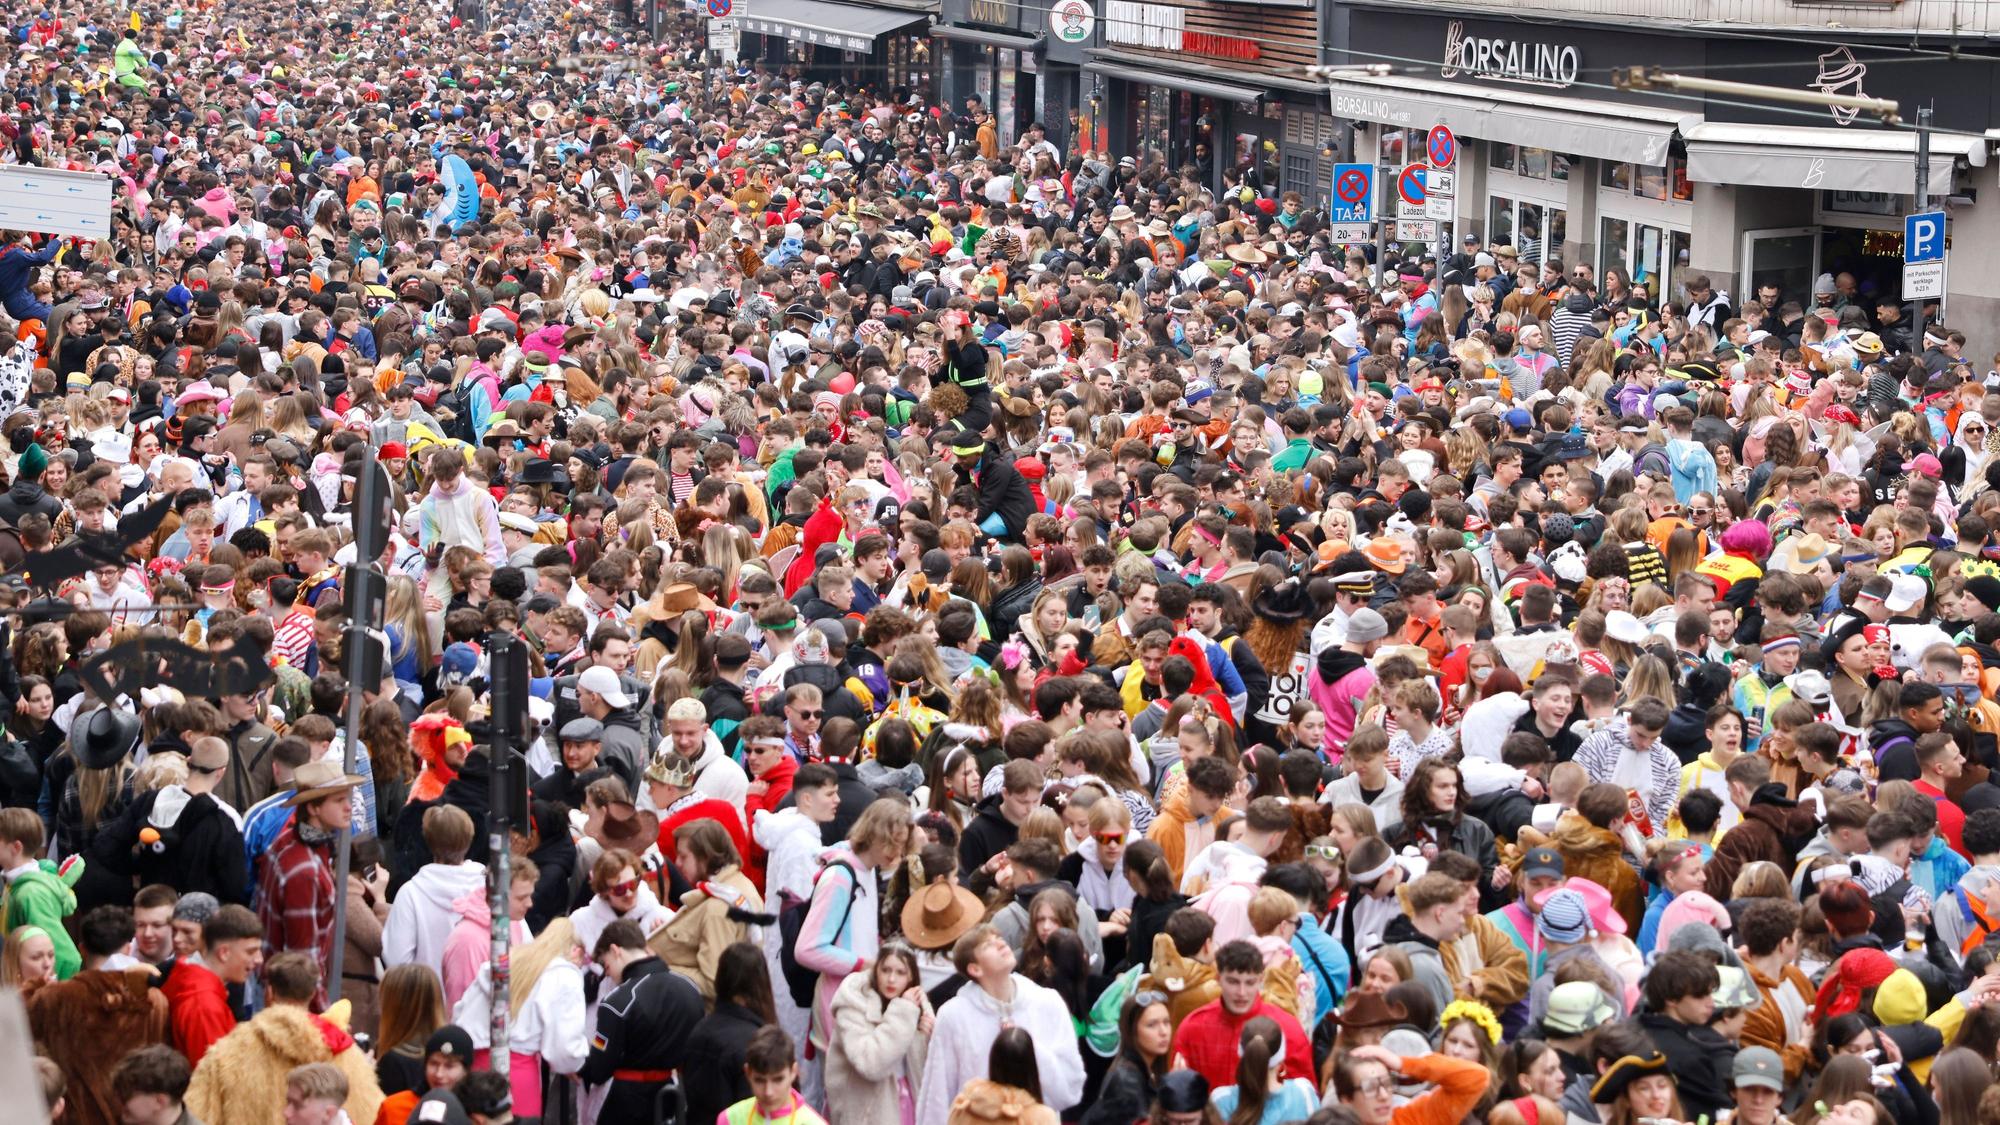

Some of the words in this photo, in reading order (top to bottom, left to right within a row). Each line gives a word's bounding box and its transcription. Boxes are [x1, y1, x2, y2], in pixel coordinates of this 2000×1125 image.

[1441, 20, 1578, 83] BORSALINO
[1336, 96, 1389, 119] BORSALINO
[1335, 207, 1367, 221] TAXI
[1403, 206, 1426, 216] Ladezo
[1361, 230, 1368, 240] h
[1914, 220, 1936, 257] P
[367, 298, 386, 308] 33
[885, 505, 898, 515] FBI
